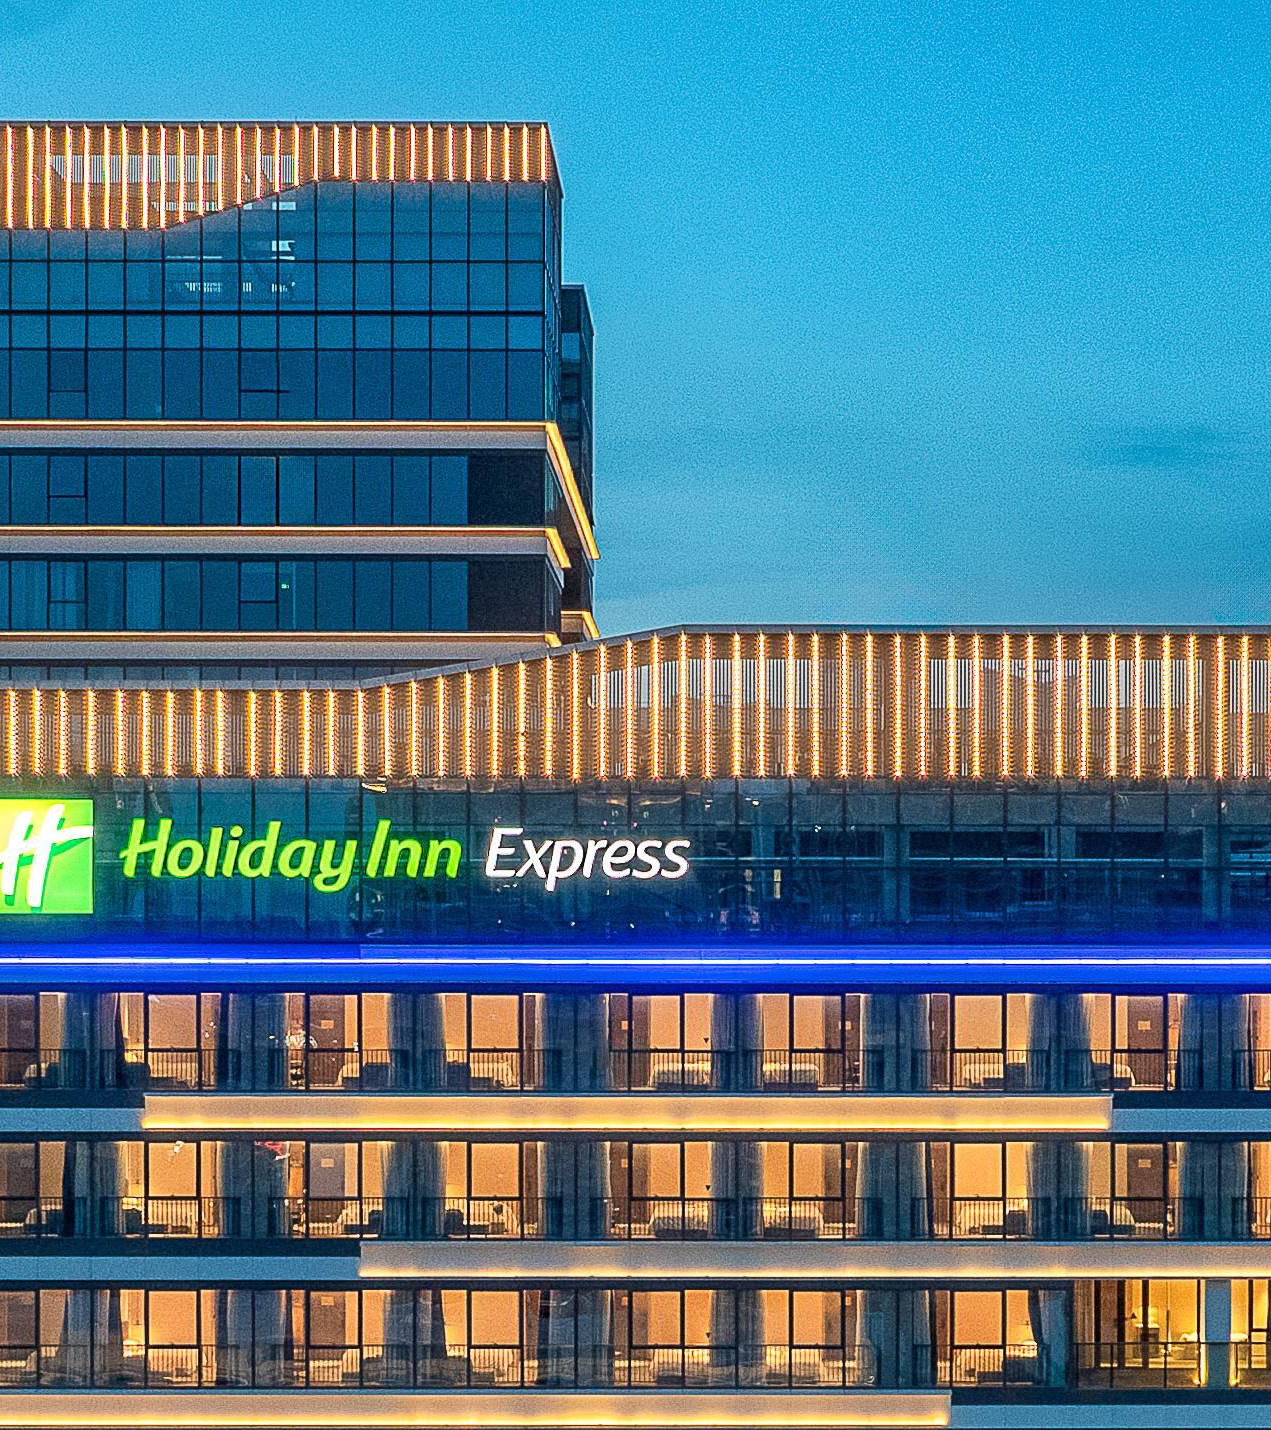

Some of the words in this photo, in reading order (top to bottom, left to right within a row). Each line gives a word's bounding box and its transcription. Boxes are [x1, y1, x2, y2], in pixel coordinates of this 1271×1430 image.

[119, 818, 358, 893] Holiday
[368, 818, 462, 879] Inn
[484, 828, 692, 892] Express
